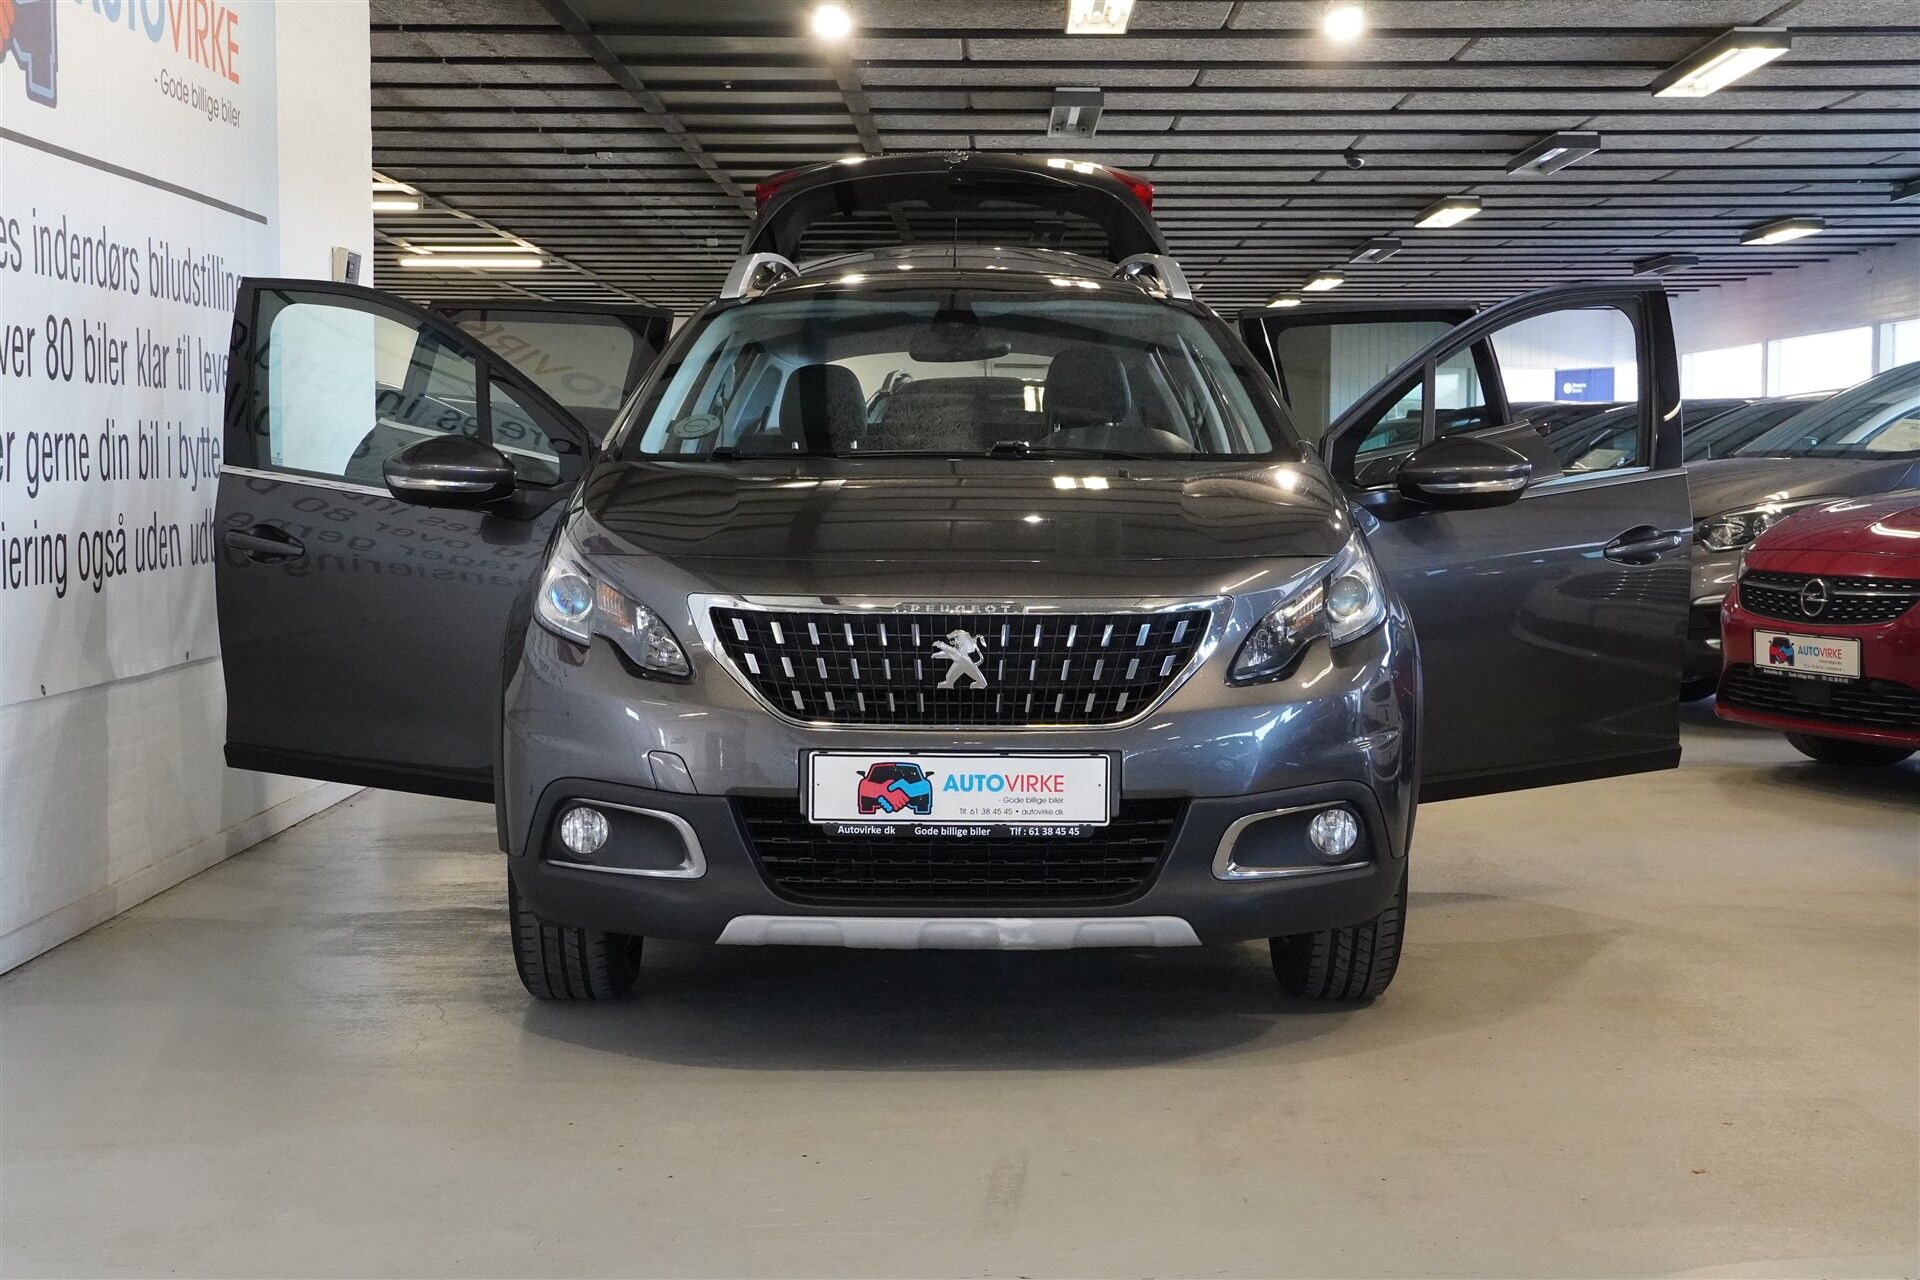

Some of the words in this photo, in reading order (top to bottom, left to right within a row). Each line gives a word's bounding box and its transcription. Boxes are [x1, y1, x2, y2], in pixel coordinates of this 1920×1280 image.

[160, 68, 190, 104] Gode
[191, 82, 219, 121] billige
[221, 97, 241, 128] biler
[32, 208, 139, 295] indendørs
[46, 314, 73, 382] 80
[83, 318, 128, 385] biler
[136, 327, 170, 389] klar
[176, 334, 191, 391] til
[26, 431, 90, 499] gerne
[99, 418, 129, 481] din
[138, 419, 159, 480] bil
[167, 421, 171, 479] i
[179, 421, 220, 491] bytte
[78, 513, 127, 593] også
[136, 511, 182, 573] uden
[910, 604, 1012, 614] PEUGEOT
[1797, 645, 1842, 660] AUTOVIRKE
[943, 774, 1064, 793] AUTOVIRKE
[1002, 796, 1024, 804] Gode
[1025, 796, 1047, 805] billige
[1048, 796, 1064, 804] biler
[969, 807, 979, 815] 61
[981, 807, 991, 815] 38
[992, 807, 1002, 815] 45
[1003, 807, 1013, 815] 45
[837, 825, 882, 835] Autovirke
[884, 825, 896, 835] dk
[914, 826, 939, 836] Gode
[940, 826, 968, 838] billige
[969, 827, 991, 836] biler
[1009, 827, 1022, 836] Tlf
[1028, 827, 1040, 836] 61
[1042, 827, 1054, 836] 38
[1055, 827, 1067, 836] 45
[1068, 827, 1080, 836] 45
